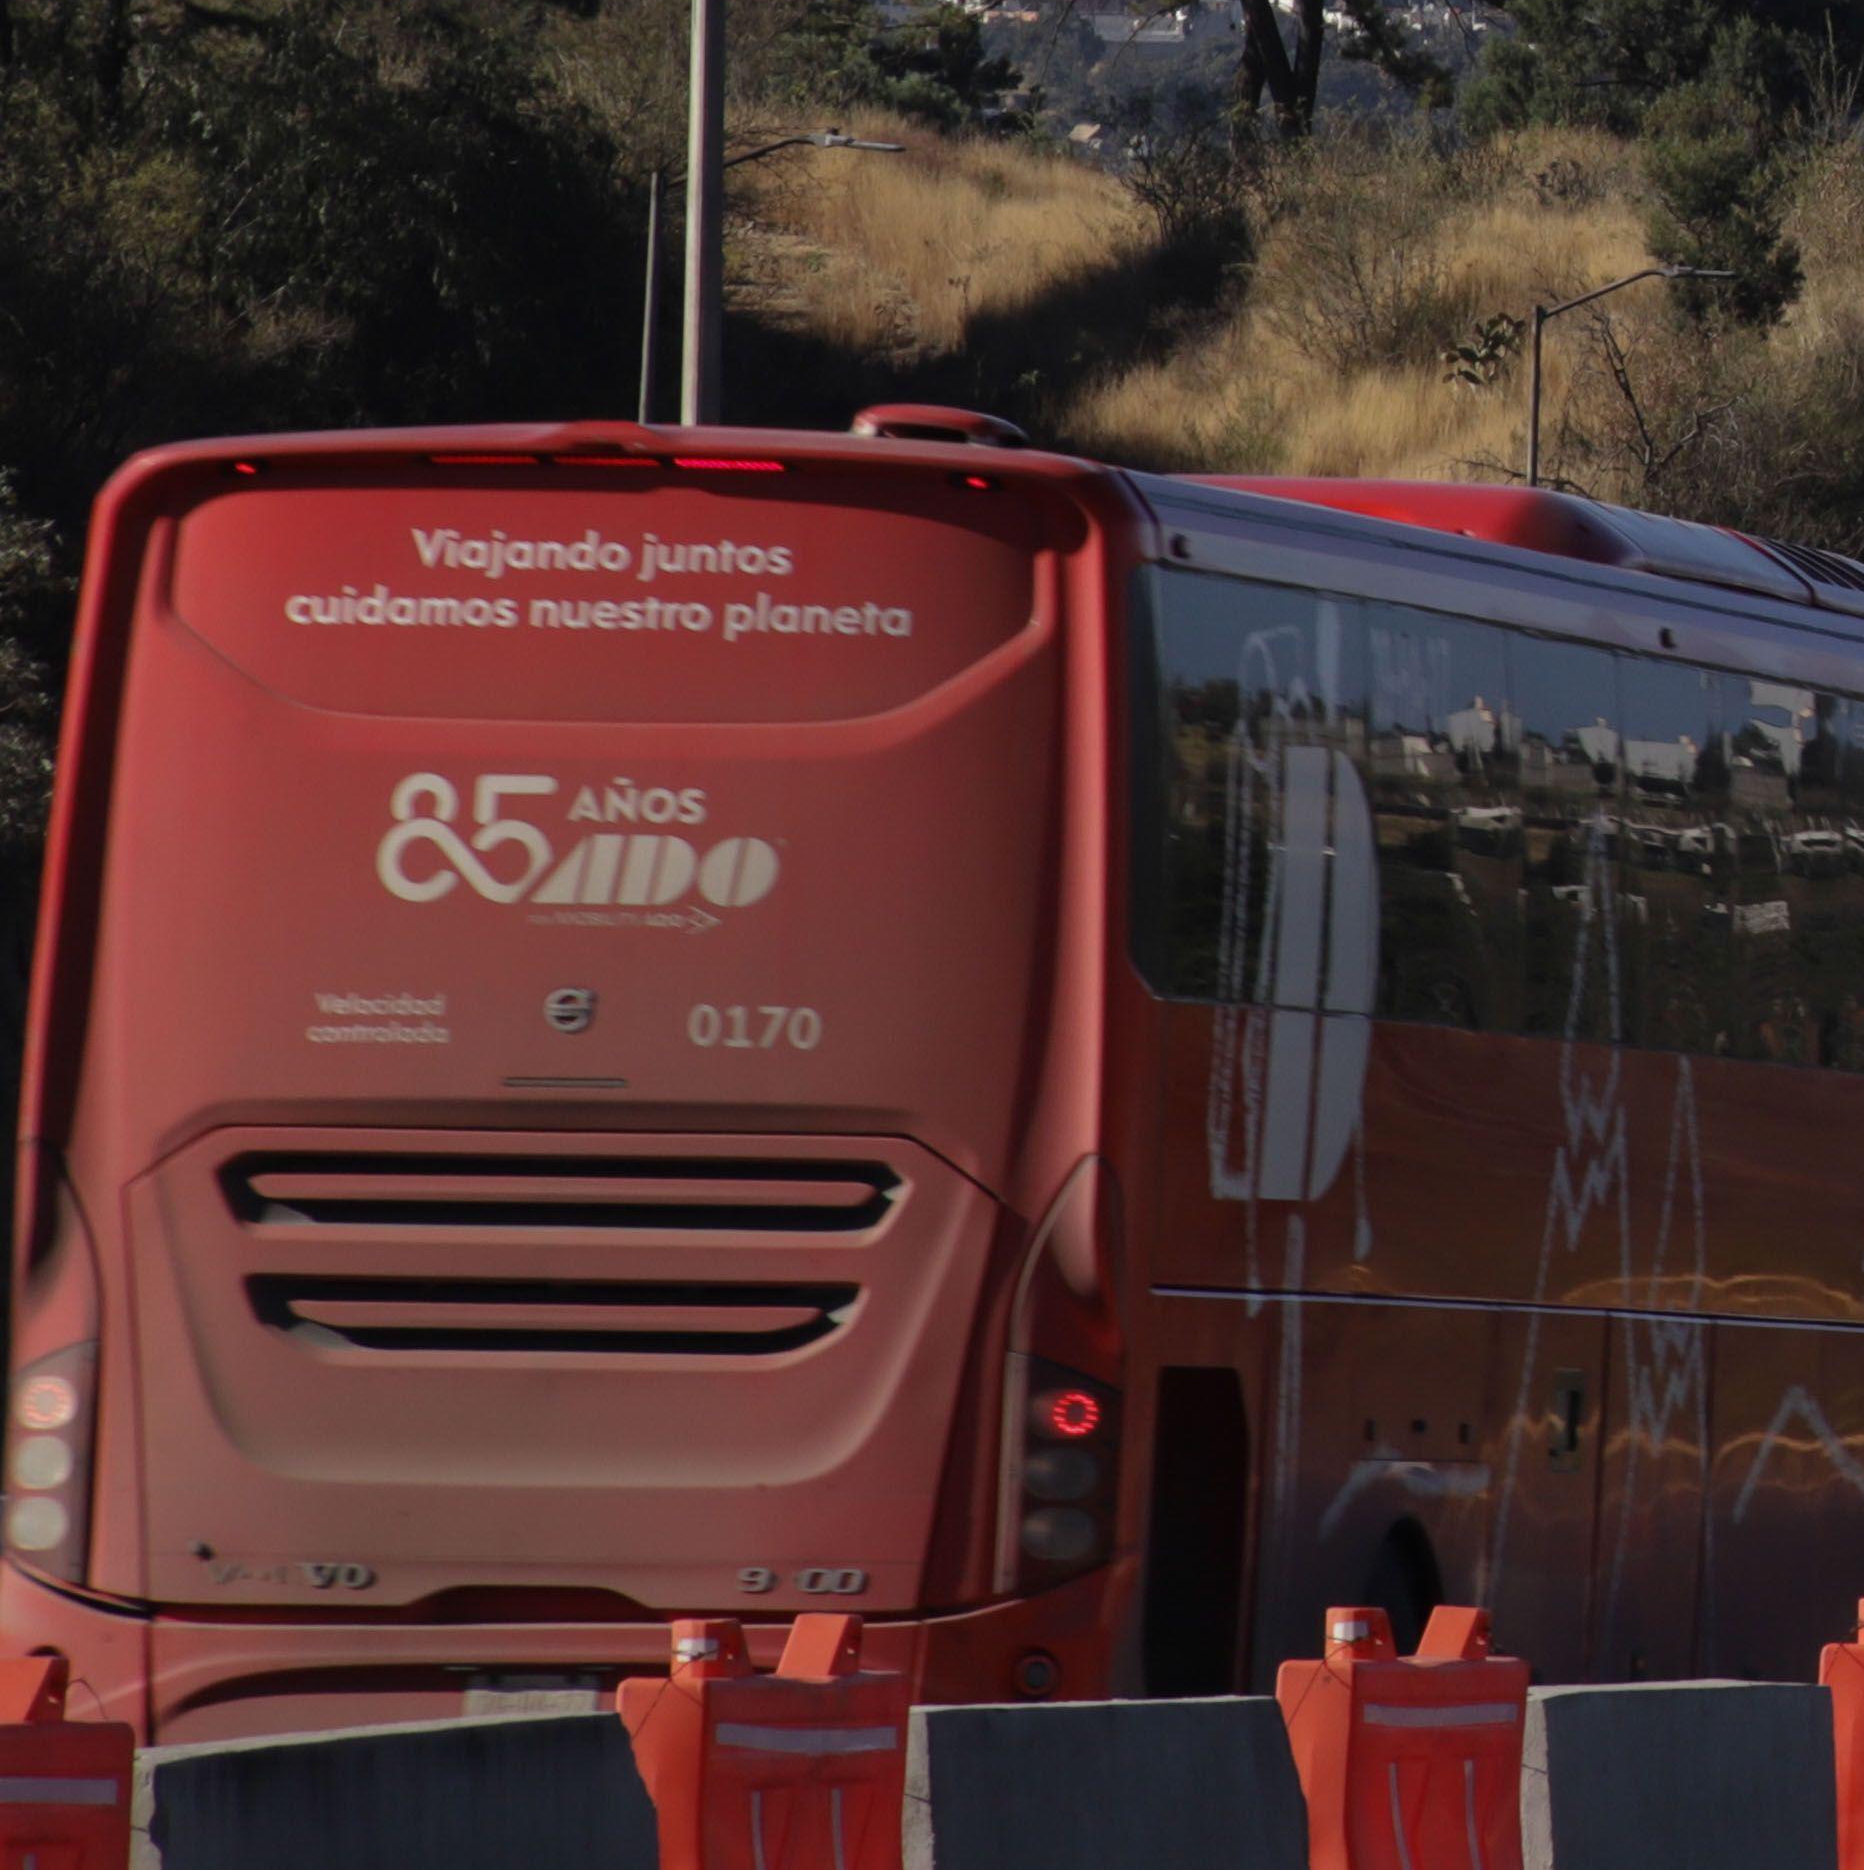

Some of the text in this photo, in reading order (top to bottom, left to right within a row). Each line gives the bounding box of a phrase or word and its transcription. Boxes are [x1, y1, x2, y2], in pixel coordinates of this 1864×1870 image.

[411, 529, 793, 582] Viajando juntos
[285, 587, 913, 642] cuidamos nuestro planeta
[567, 776, 707, 825] AÑOS
[376, 772, 559, 904] 85
[687, 1003, 822, 1050] 0170
